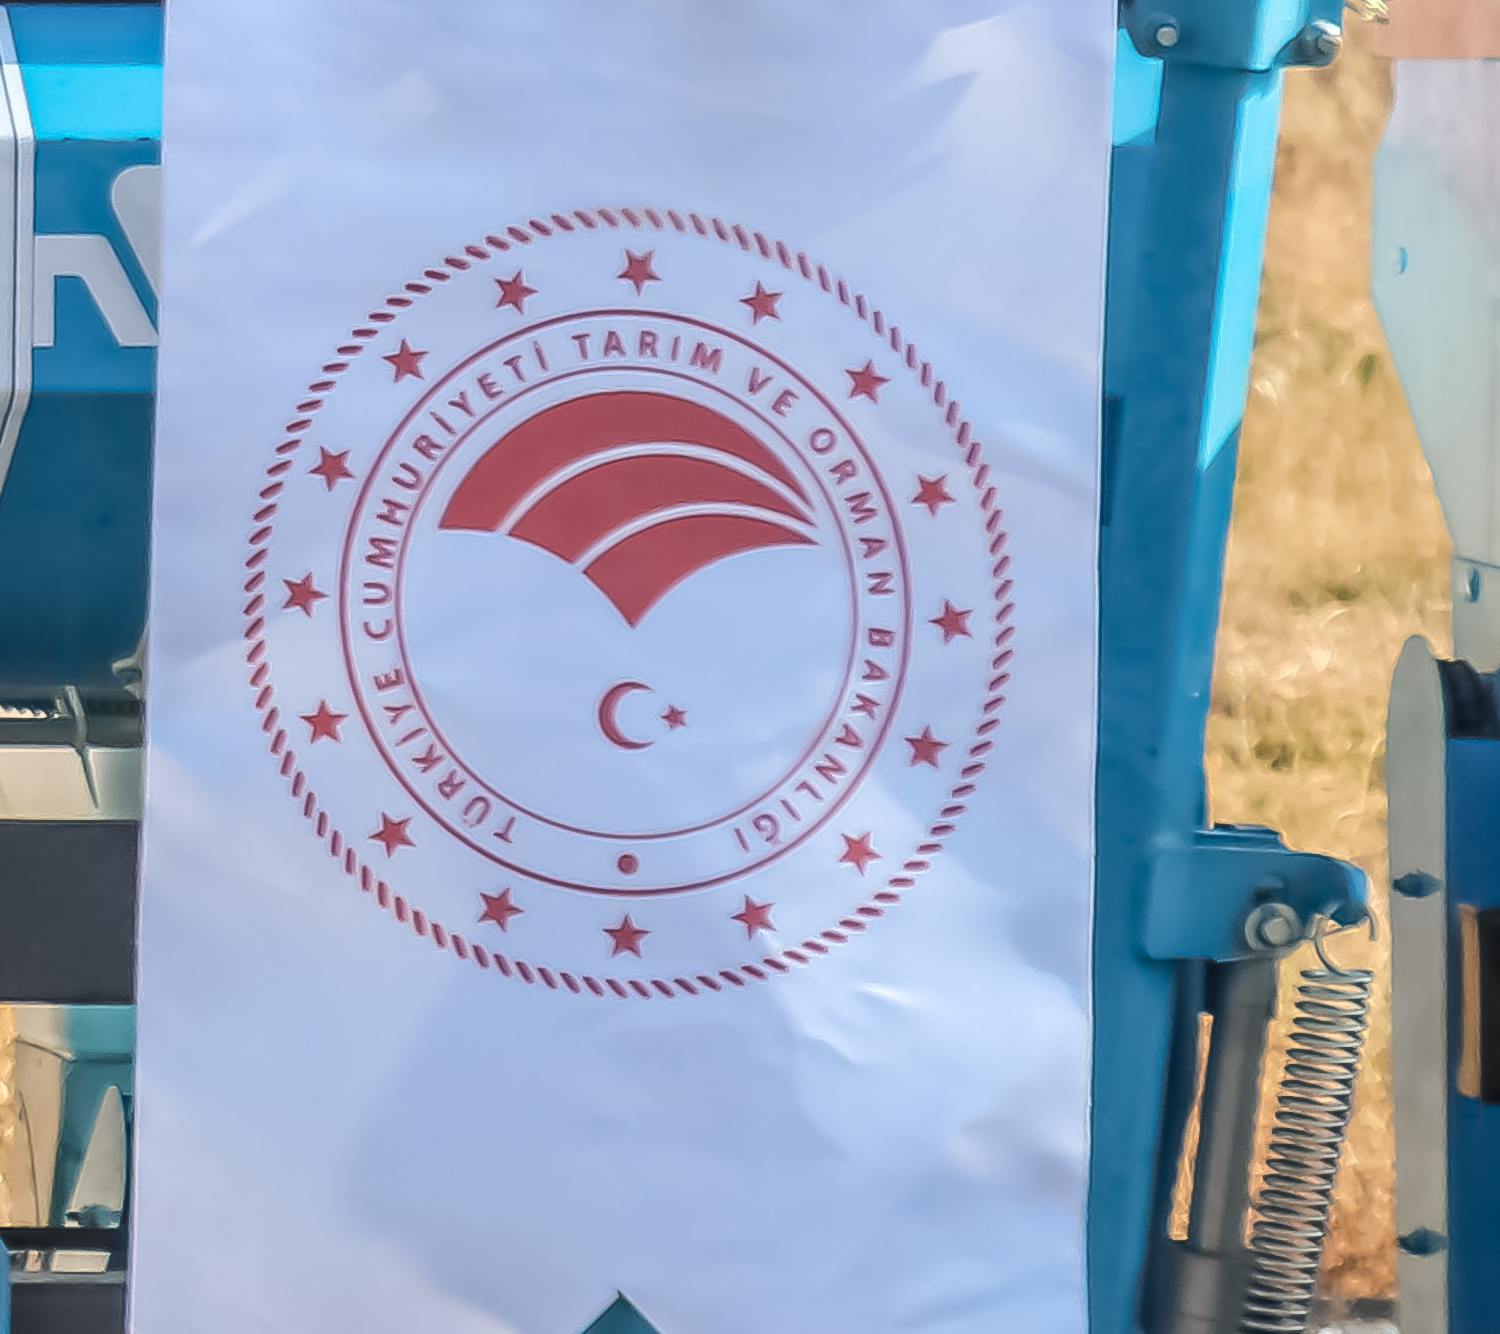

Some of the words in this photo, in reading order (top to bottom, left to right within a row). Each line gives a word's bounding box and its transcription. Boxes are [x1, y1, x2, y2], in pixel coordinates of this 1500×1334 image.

[570, 329, 723, 374] TARIM
[746, 367, 800, 417] VE
[364, 341, 549, 642] CUMHURİYETİ
[809, 426, 896, 595] ORMAN
[376, 667, 518, 845] TÜRKİYE
[733, 626, 897, 853] BAKANLIĞI
